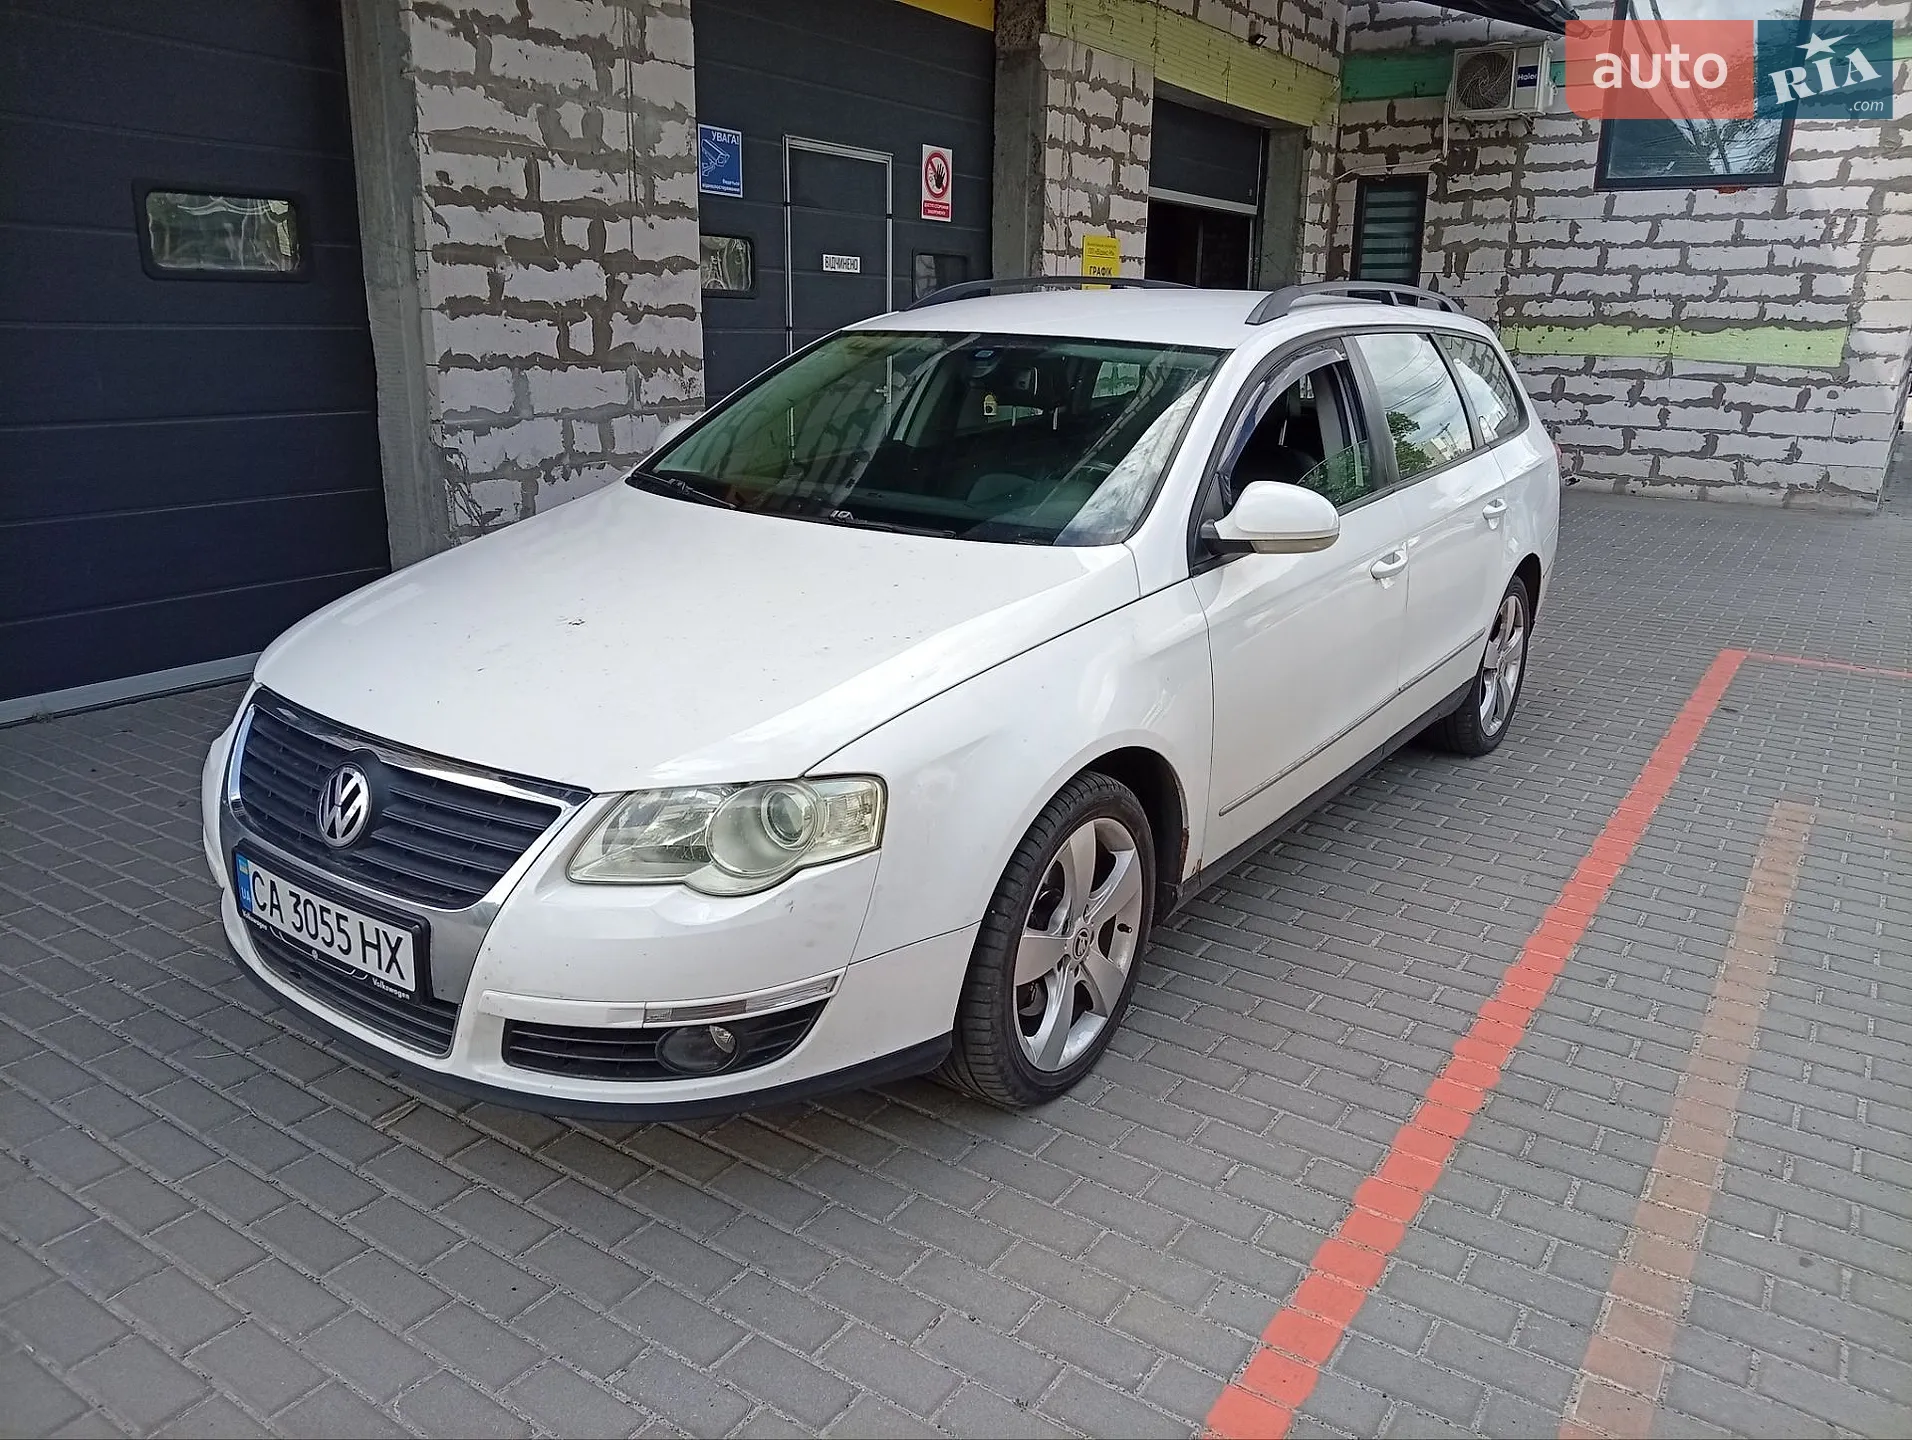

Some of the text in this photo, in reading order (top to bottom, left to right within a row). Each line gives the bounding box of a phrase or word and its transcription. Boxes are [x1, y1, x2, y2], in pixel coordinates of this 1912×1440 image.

[1517, 72, 1538, 81] Haier
[711, 131, 740, 145] УВАГА!
[824, 256, 859, 271] ВІДЧИНЕНО
[252, 870, 406, 981] CA 3055 HX
[372, 977, 410, 1001] Volkswagen
